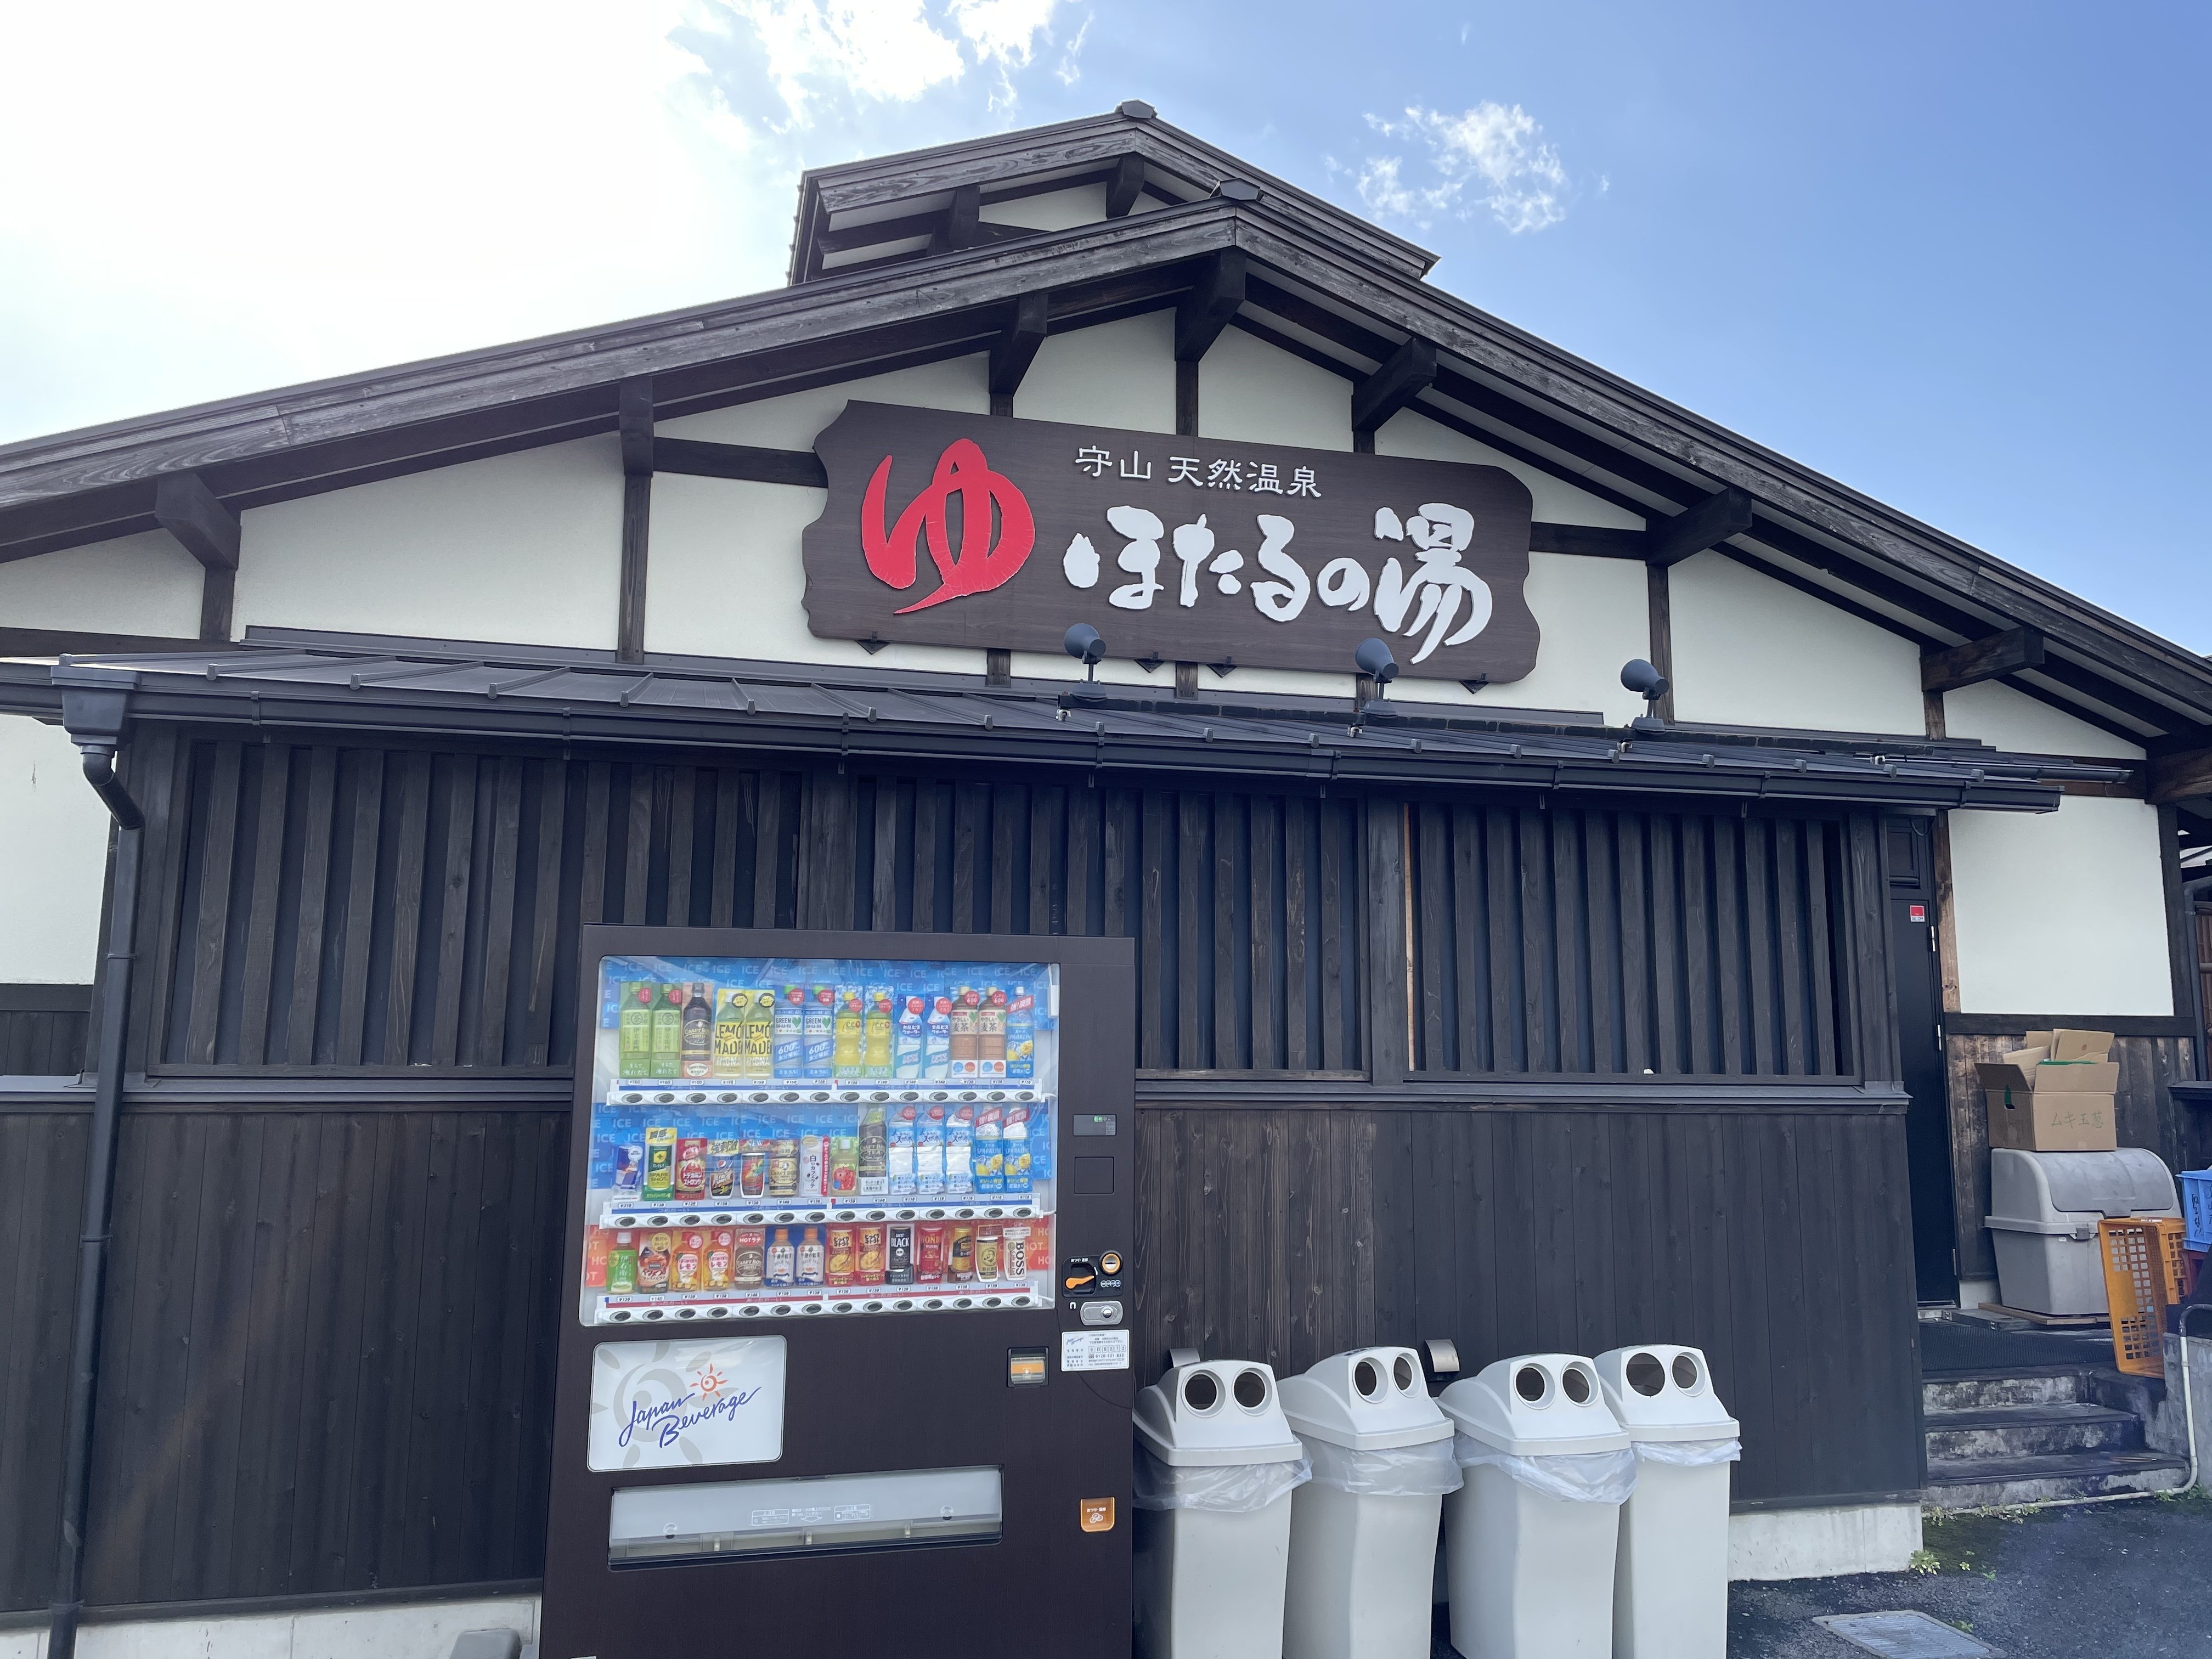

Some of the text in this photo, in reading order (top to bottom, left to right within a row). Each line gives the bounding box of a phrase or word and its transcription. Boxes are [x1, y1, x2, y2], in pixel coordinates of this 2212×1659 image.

[1075, 445, 1323, 498] 守山 天然温泉
[861, 438, 1035, 615] ゆ
[1063, 501, 1493, 665] ほたるの湯
[625, 963, 642, 971] ICE
[654, 963, 672, 972] ICE
[685, 964, 702, 973] ICE
[742, 966, 759, 974] ICE
[770, 966, 788, 974] ICE
[829, 967, 845, 975] ICE
[856, 968, 873, 977] ICE
[884, 969, 900, 977] ICE
[910, 969, 927, 978] ICE
[952, 1024, 969, 1032] 麦茶
[981, 1024, 997, 1032] 麦茶
[599, 1105, 617, 1113] ICE
[613, 1119, 631, 1127] ICE
[644, 1119, 662, 1127] ICE
[673, 1118, 690, 1126] ICE
[759, 1115, 776, 1123] ICE
[788, 1115, 805, 1123] ICE
[743, 1130, 761, 1138] ICE
[772, 1129, 790, 1137] ICE
[597, 1134, 615, 1143] ICE
[628, 1133, 645, 1142] ICE
[596, 1164, 613, 1172] ICE
[891, 1238, 909, 1247] BLACK
[1016, 1242, 1024, 1276] BOSS
[618, 1393, 695, 1447] Japan
[652, 1387, 761, 1448] Beverage
